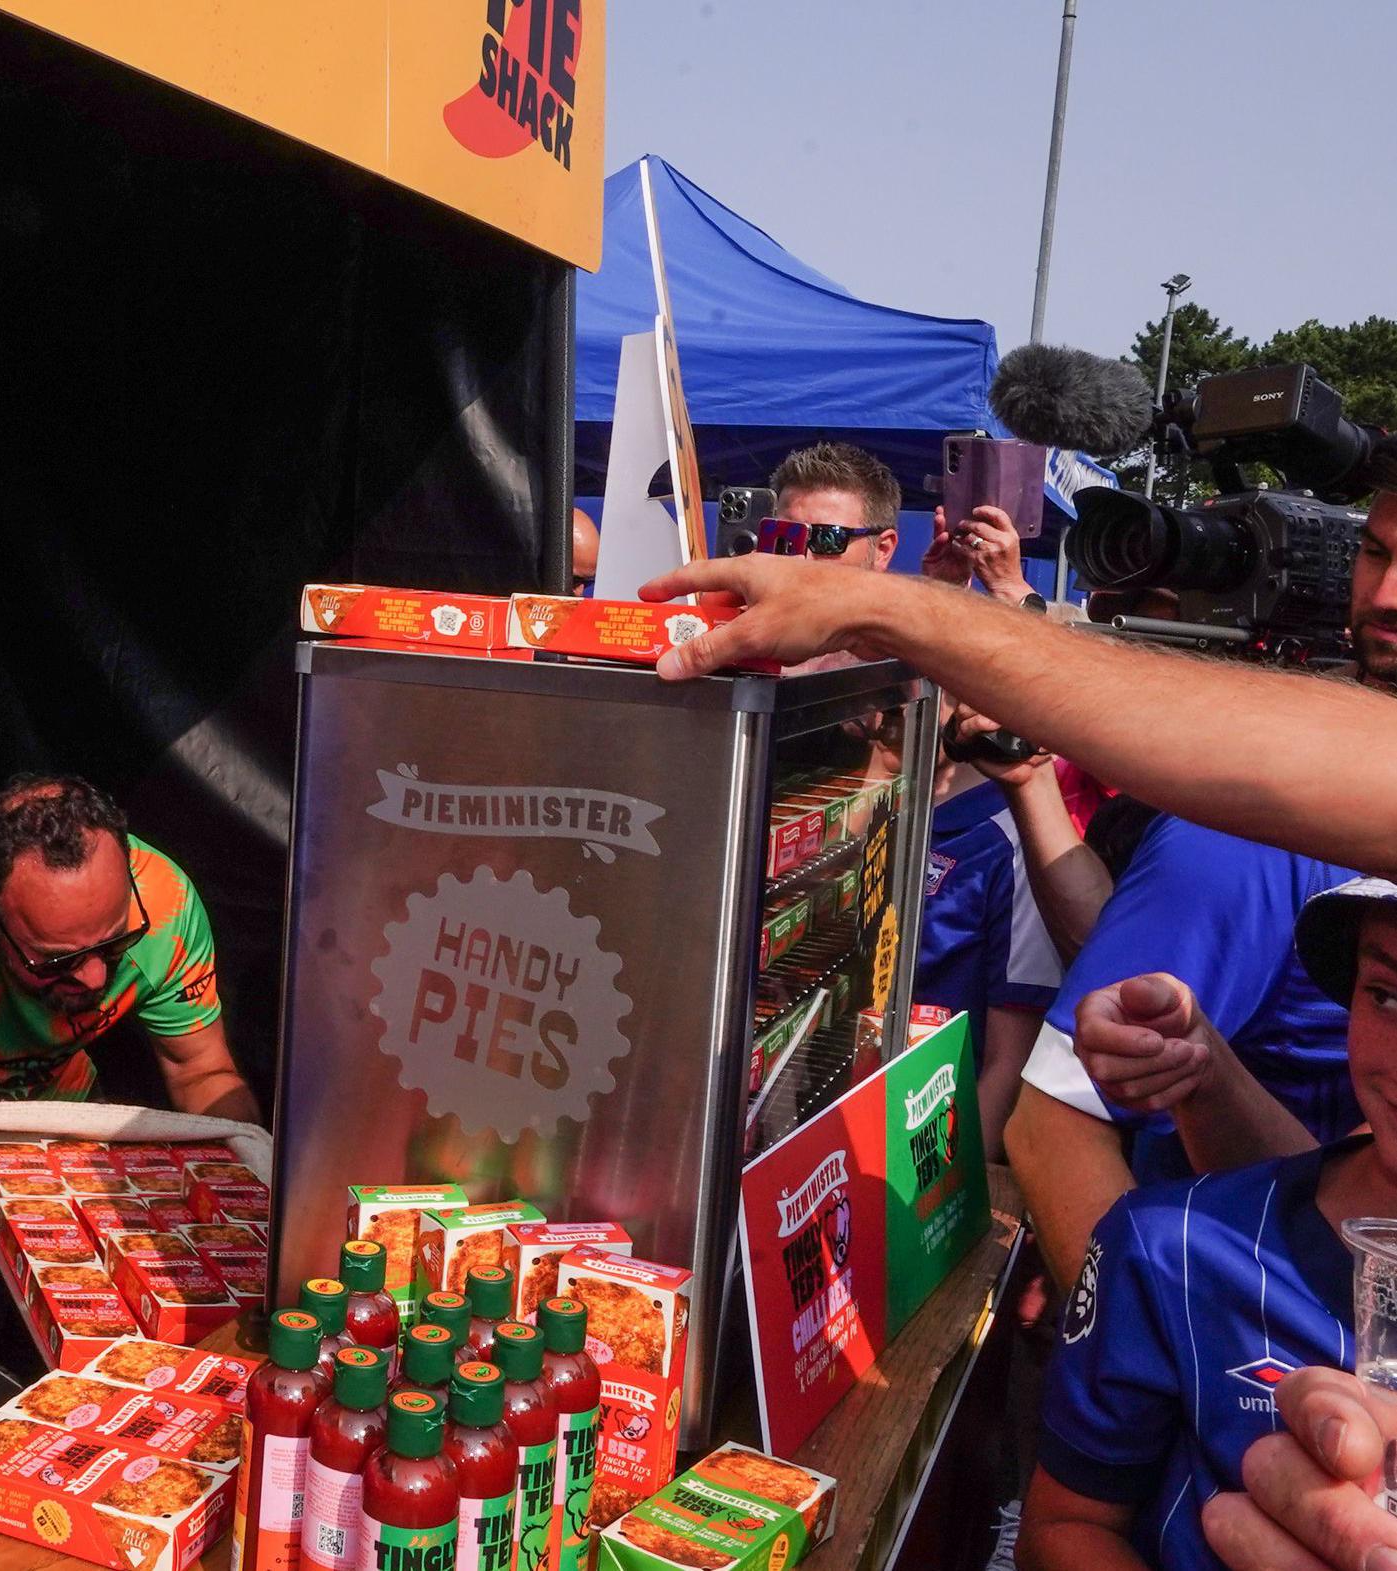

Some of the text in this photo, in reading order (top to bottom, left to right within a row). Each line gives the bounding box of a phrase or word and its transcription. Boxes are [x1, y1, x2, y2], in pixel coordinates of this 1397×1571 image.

[479, 33, 573, 172] SHACK
[1253, 391, 1284, 402] SONY
[528, 613, 553, 621] FILLED
[531, 605, 551, 614] DEEP
[402, 788, 632, 838] PIEMINISTER
[434, 916, 580, 1000] HANDY
[409, 968, 580, 1090] PIES
[912, 1070, 951, 1123] PIEMINISTER
[909, 1117, 939, 1167] TINGLY
[916, 1149, 941, 1192] TED'S
[785, 1157, 841, 1230] PIEMINISTER
[782, 1219, 823, 1282] TINGLY
[790, 1261, 825, 1311] TED'S
[792, 1268, 853, 1353] CHILLI BEEF
[563, 1424, 598, 1455] TIN
[608, 1438, 646, 1461] BEEF
[518, 1457, 555, 1490] TIN
[570, 1451, 596, 1480] TE
[600, 1452, 651, 1476] TINGLY TED'S
[602, 1465, 644, 1483] HANDY PIE
[525, 1490, 553, 1516] TE
[673, 1488, 728, 1513] TINGLY
[692, 1485, 770, 1516] PIEMINISTER
[122, 1536, 151, 1550] FILLED
[124, 1527, 148, 1539] DEEP
[474, 1511, 513, 1544] TIN
